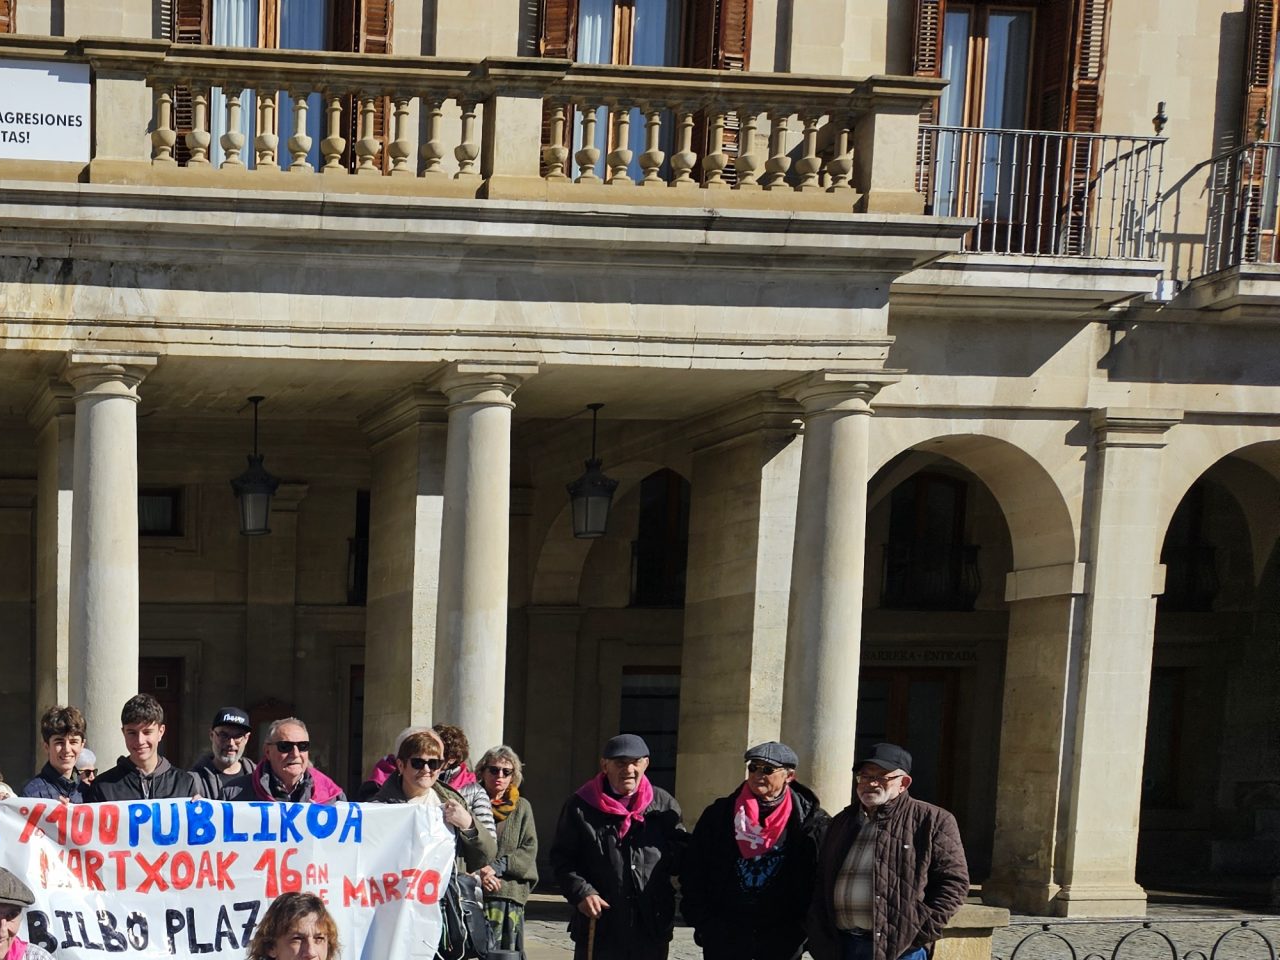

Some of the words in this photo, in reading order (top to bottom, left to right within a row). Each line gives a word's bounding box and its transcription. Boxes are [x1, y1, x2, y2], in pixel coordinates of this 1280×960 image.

[128, 801, 362, 847] PUBLIKOA
[253, 848, 302, 899] 16
[306, 864, 329, 885] AN
[343, 869, 441, 907] MARZO
[27, 910, 149, 953] BILBO
[166, 900, 260, 954] PLAZ
